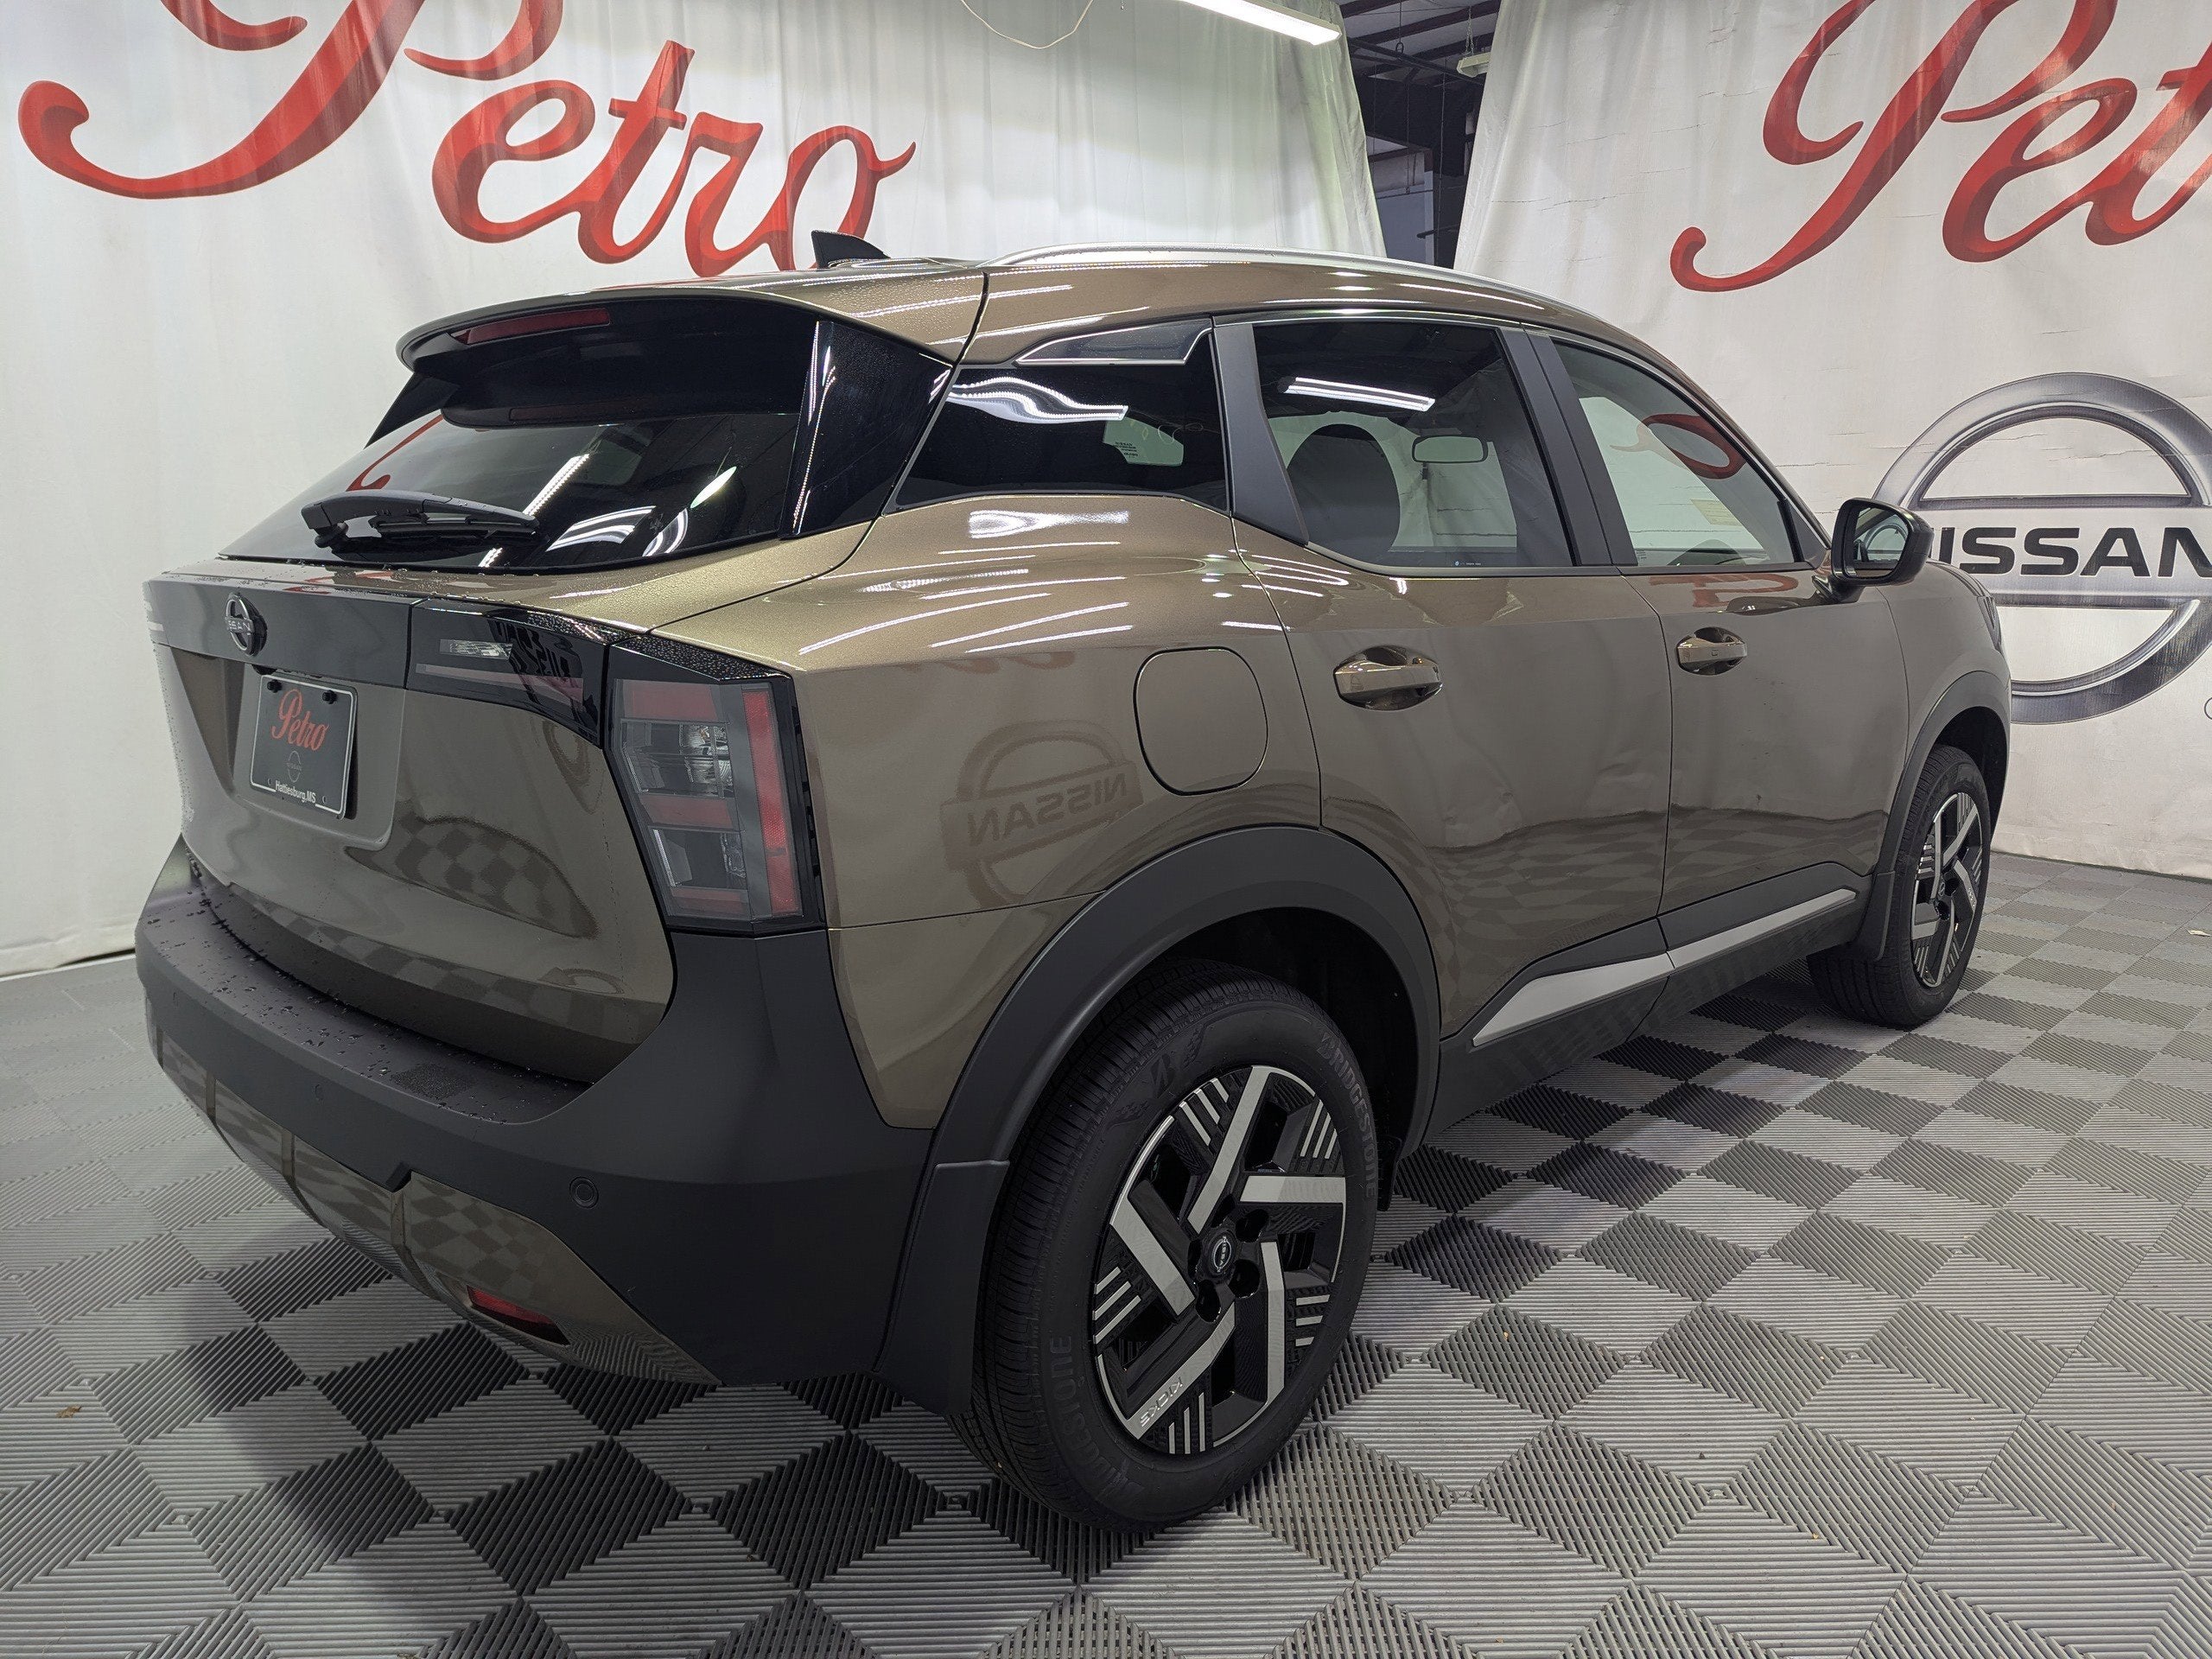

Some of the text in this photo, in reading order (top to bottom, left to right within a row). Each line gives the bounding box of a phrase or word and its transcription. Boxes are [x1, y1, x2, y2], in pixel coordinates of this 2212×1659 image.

[1928, 527, 2212, 577] ISSAN
[271, 688, 330, 752] Petro
[1316, 1032, 1377, 1198] BRIDGESTONE
[1140, 1376, 1184, 1427] KICKS
